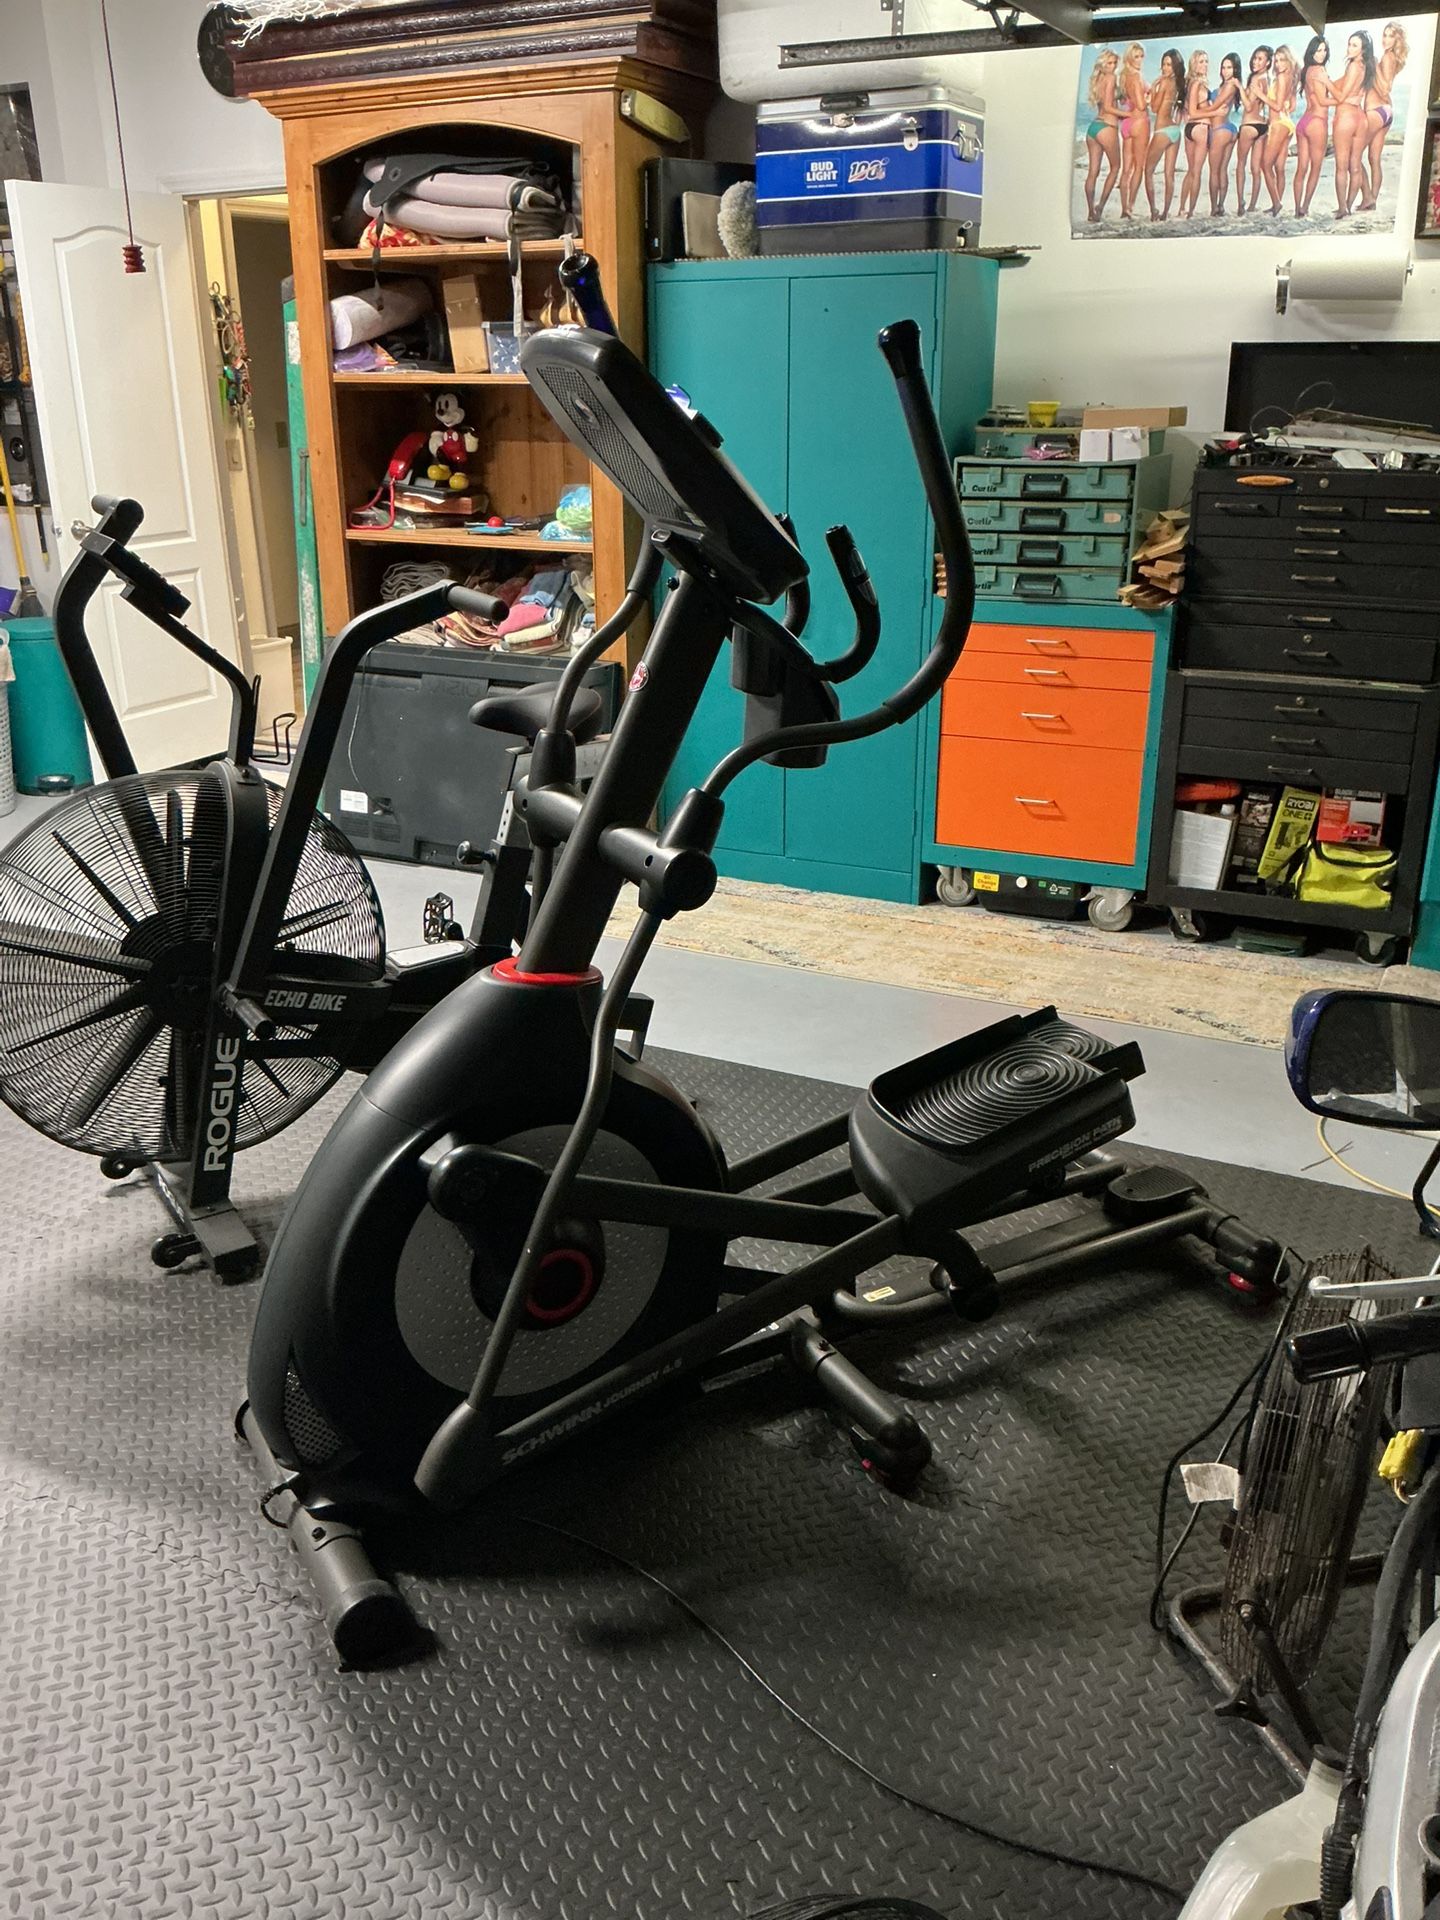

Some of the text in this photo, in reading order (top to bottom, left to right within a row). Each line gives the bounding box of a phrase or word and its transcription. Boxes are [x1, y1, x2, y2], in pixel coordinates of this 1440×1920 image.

[810, 161, 834, 171] BUD
[806, 170, 838, 182] LIGHT
[971, 484, 998, 493] Curtis
[967, 517, 993, 526] Curtis
[1287, 797, 1315, 811] RYOBI
[263, 989, 347, 1012] ECHO BIKE
[203, 1037, 241, 1172] ROGUE
[1028, 1132, 1092, 1173] PRECISION
[502, 1402, 601, 1466] SCHWINN
[602, 1370, 660, 1409] JOURNEY
